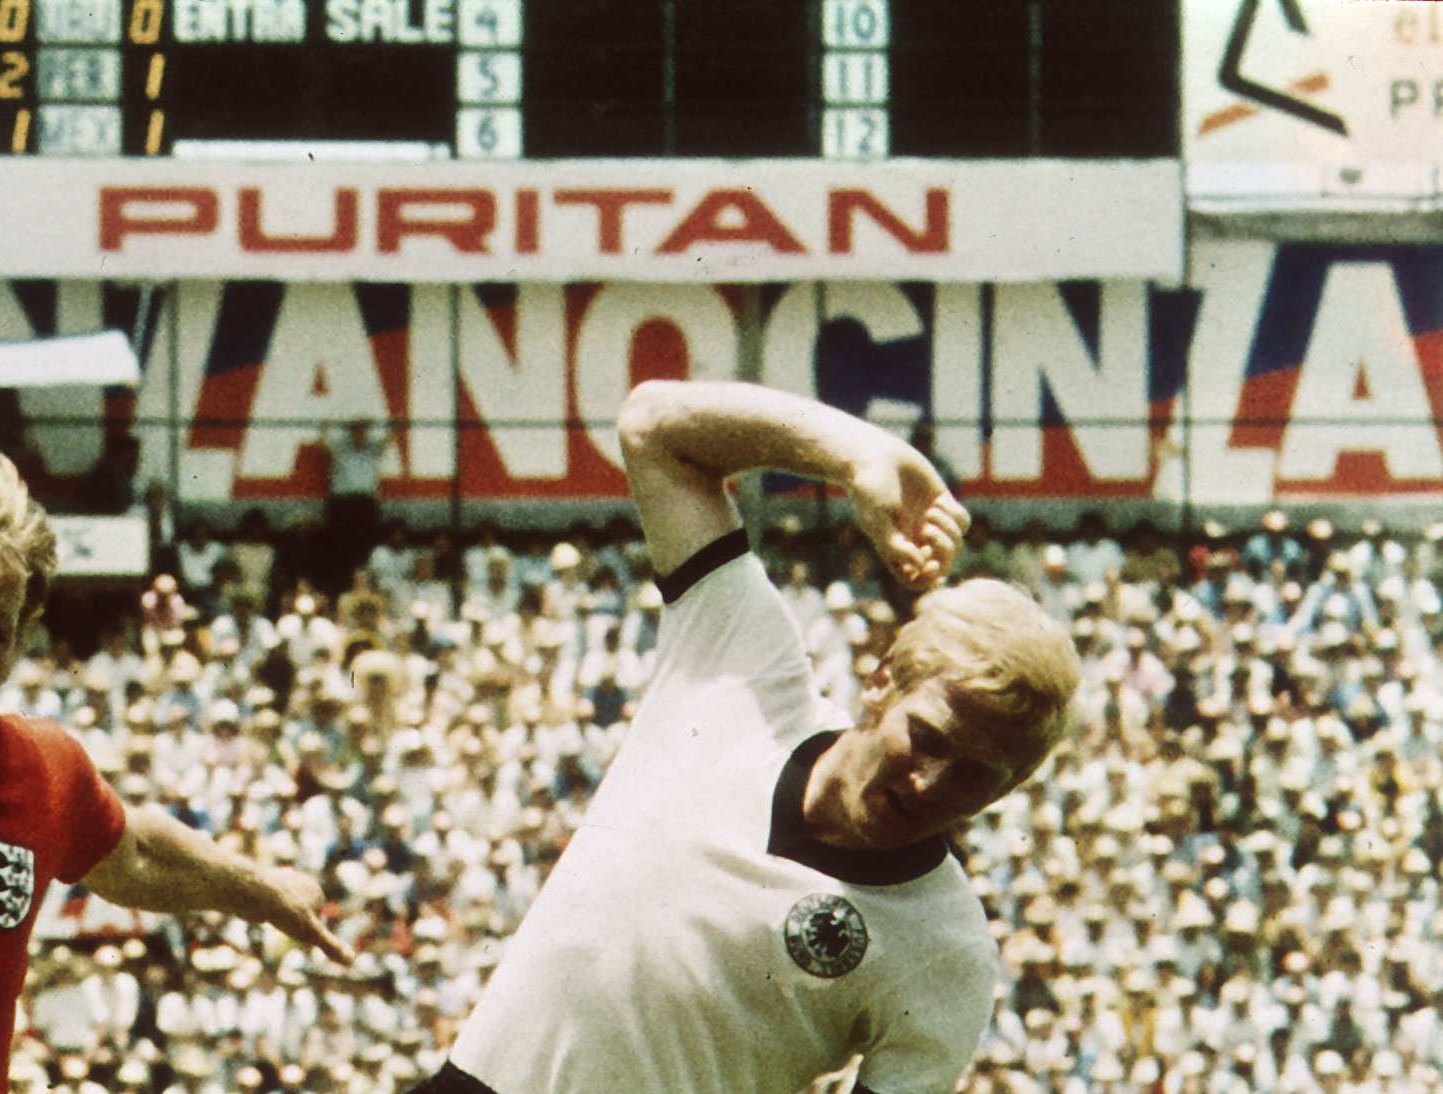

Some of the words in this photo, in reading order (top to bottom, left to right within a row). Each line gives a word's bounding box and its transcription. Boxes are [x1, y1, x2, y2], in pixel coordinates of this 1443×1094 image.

[325, 0, 454, 42] SALE
[145, 52, 165, 99] 1
[12, 107, 31, 154] 1
[145, 108, 165, 155] 1
[97, 185, 951, 255] PURITAN
